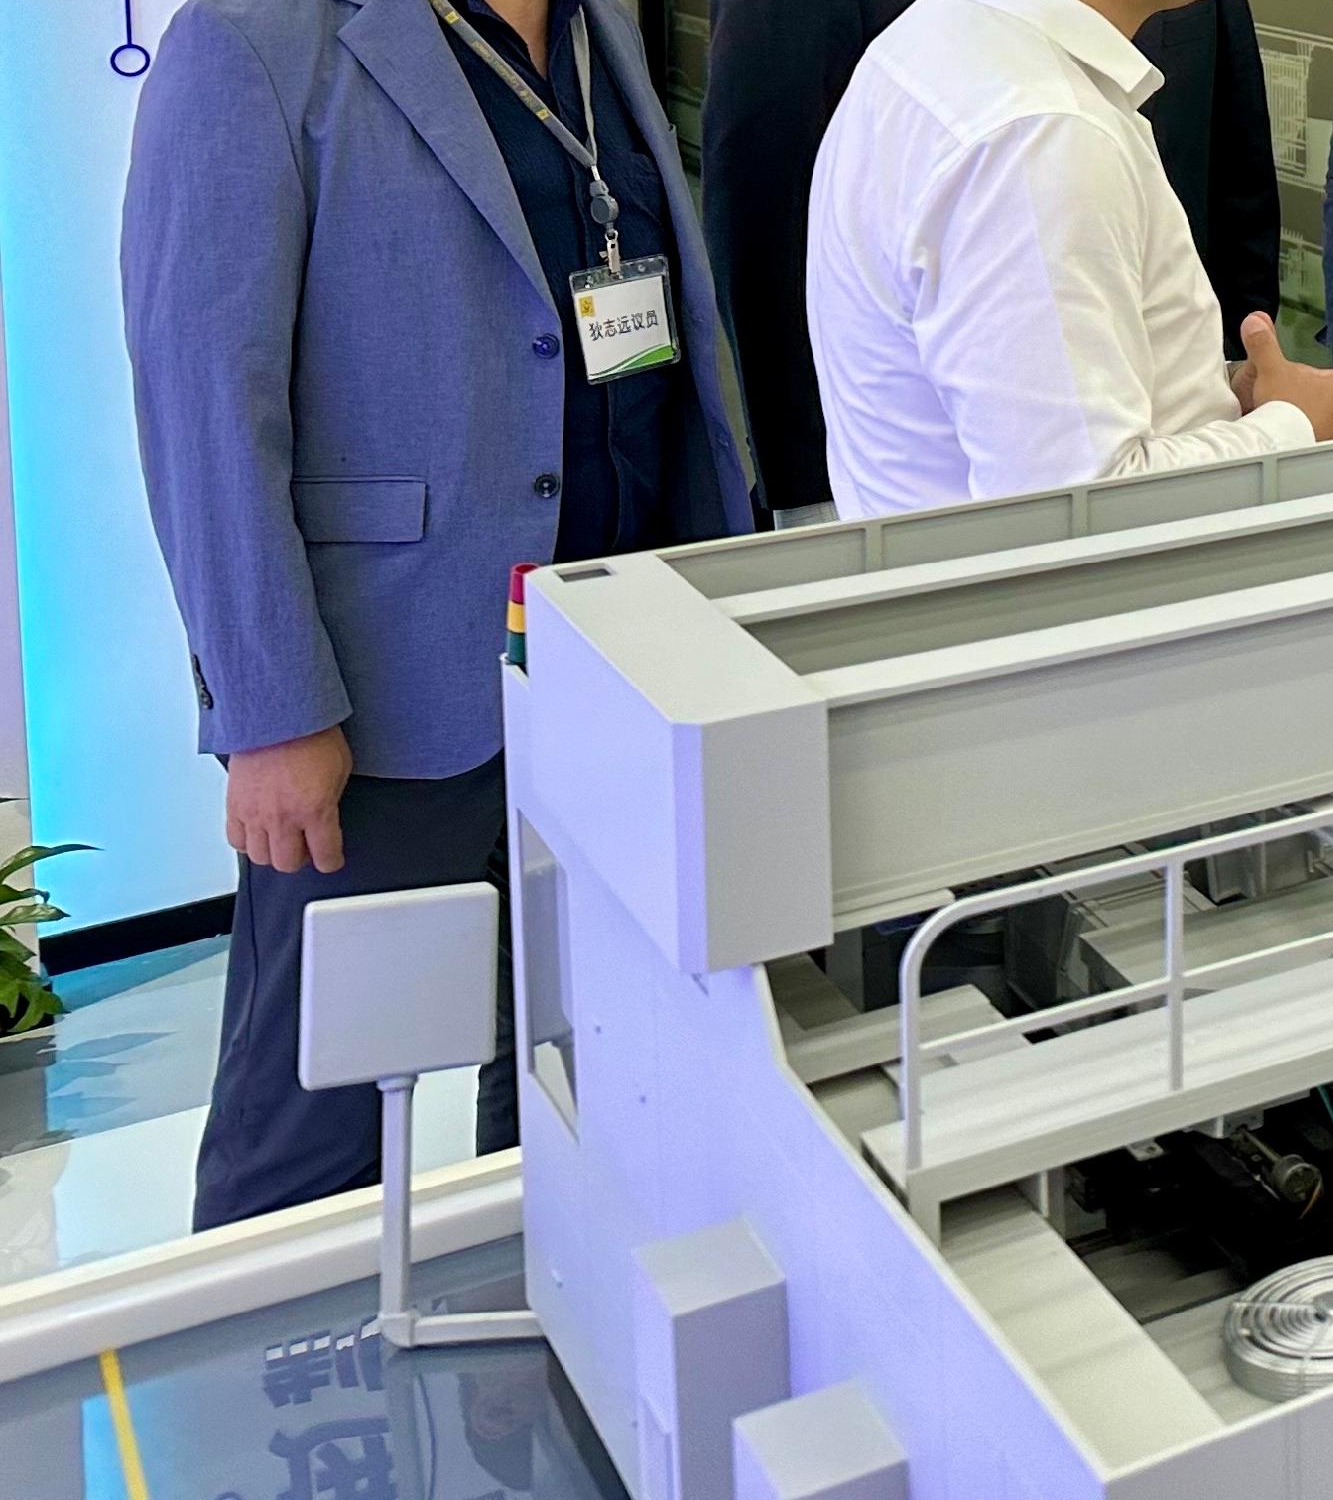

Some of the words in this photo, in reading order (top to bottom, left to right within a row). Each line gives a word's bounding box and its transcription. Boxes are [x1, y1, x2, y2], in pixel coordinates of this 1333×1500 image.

[588, 309, 660, 341] 狄志远议员
